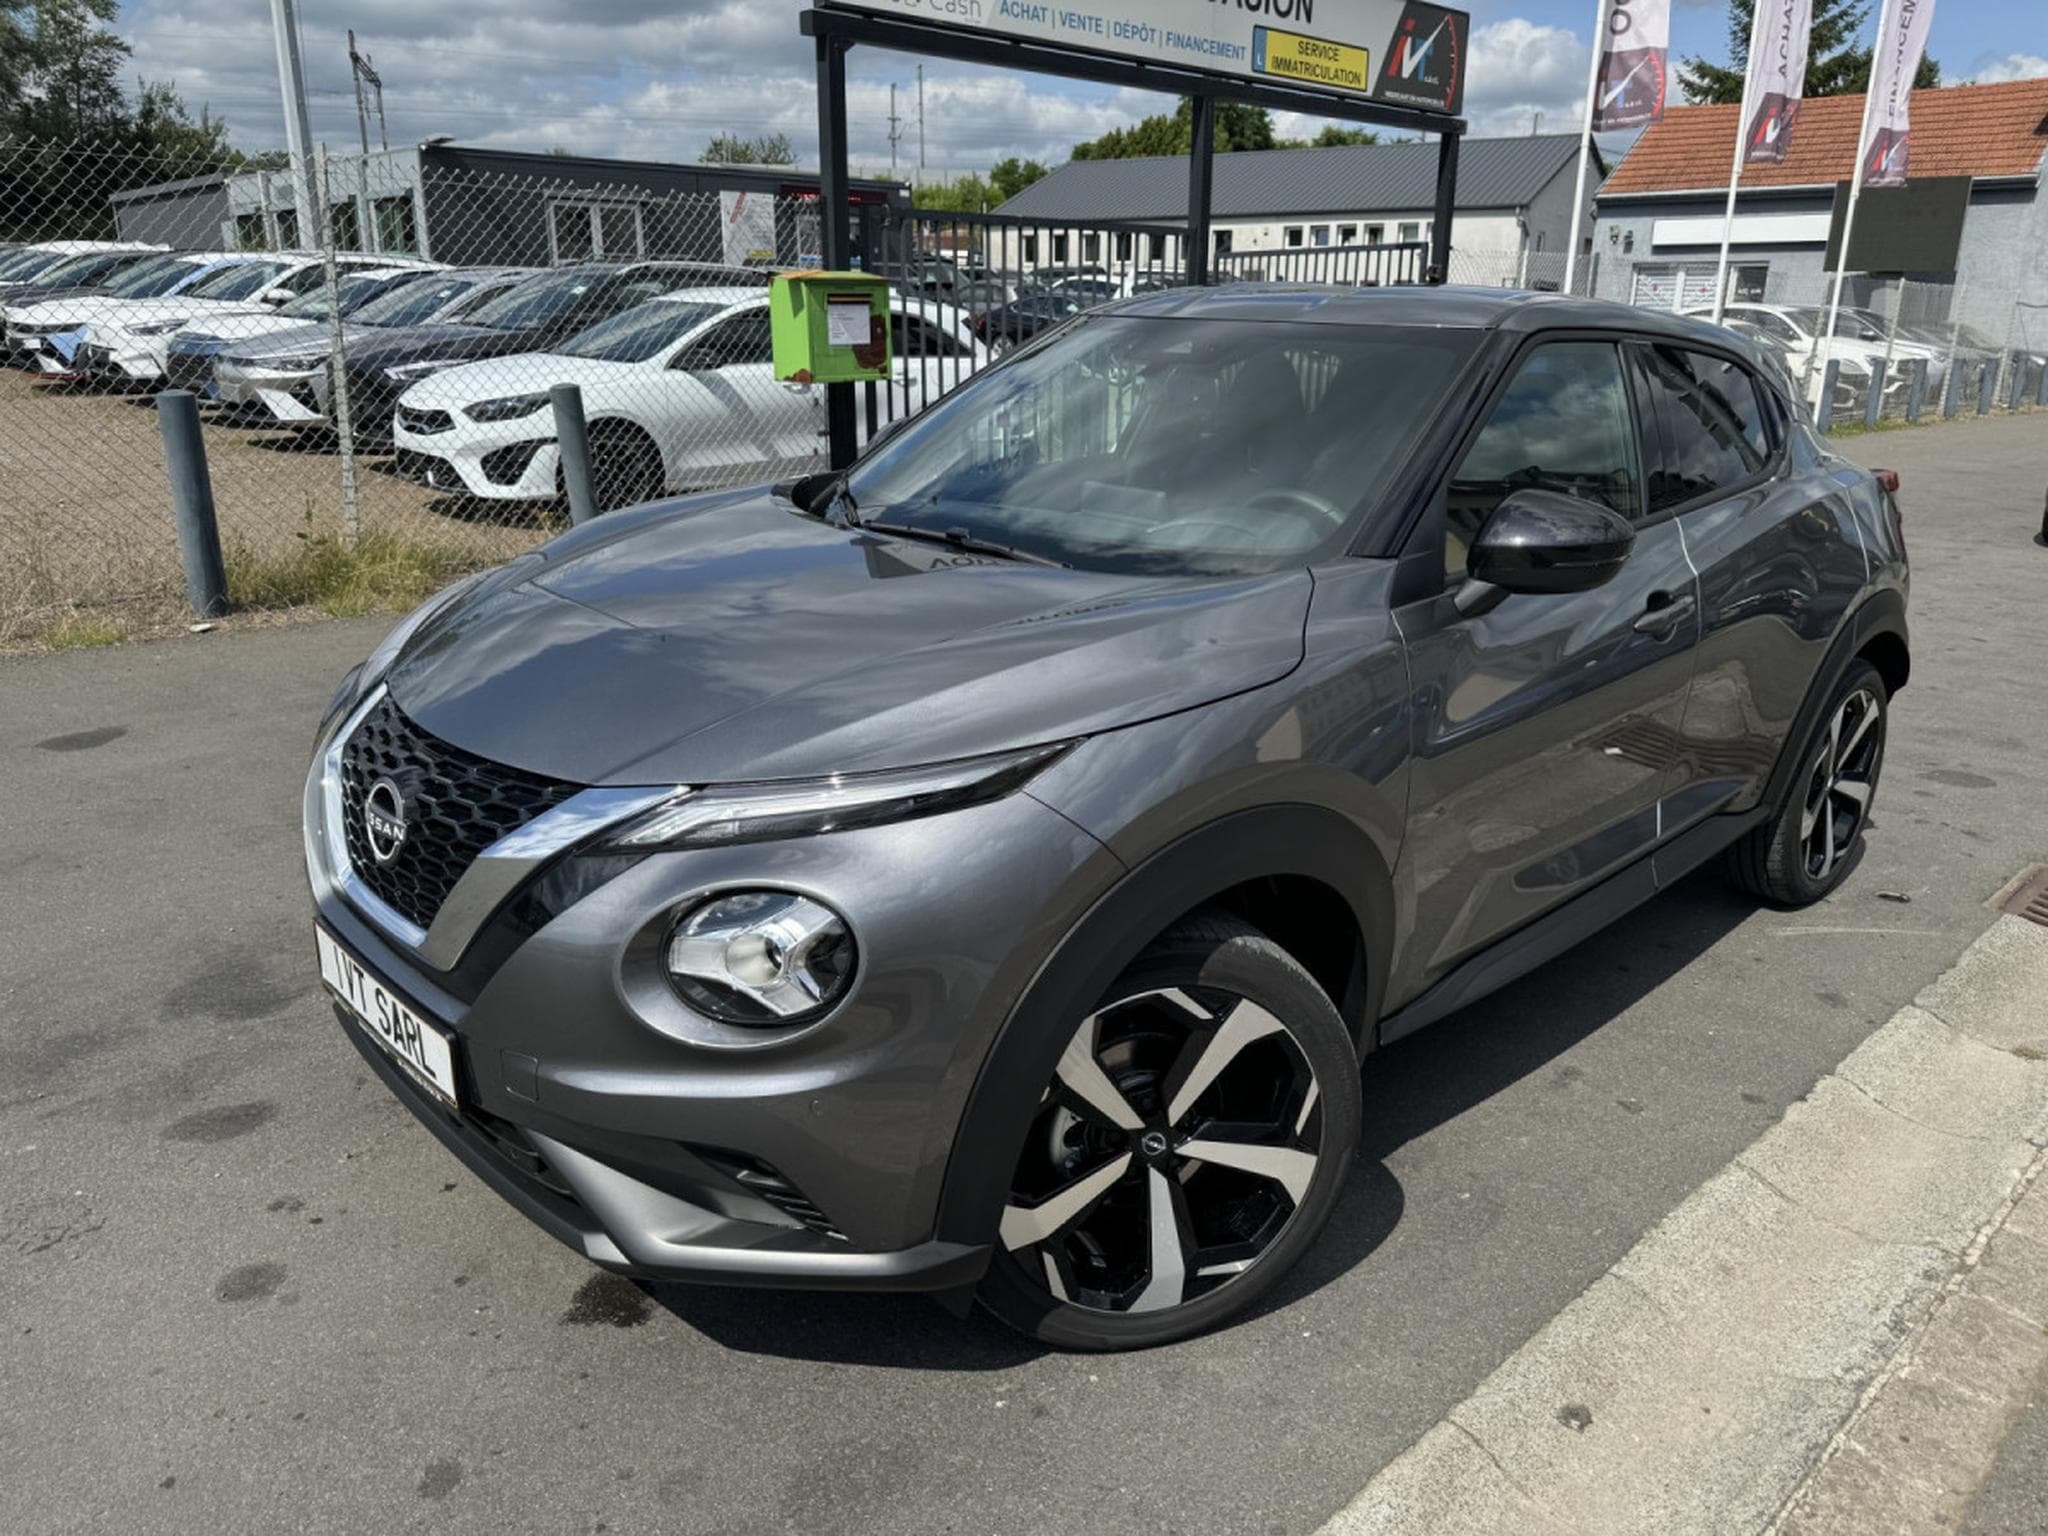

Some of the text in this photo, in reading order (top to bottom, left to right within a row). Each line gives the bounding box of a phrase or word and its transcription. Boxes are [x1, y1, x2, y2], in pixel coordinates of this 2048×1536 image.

[1000, 0, 1246, 60] ACHAT VENTE DÉPÔT FINANCEMENT
[1298, 40, 1340, 62] SERVICE
[1271, 55, 1361, 86] IMMATRICULATION
[368, 812, 406, 841] SSAN
[333, 944, 367, 1014] IVT
[375, 987, 438, 1080] SARL
